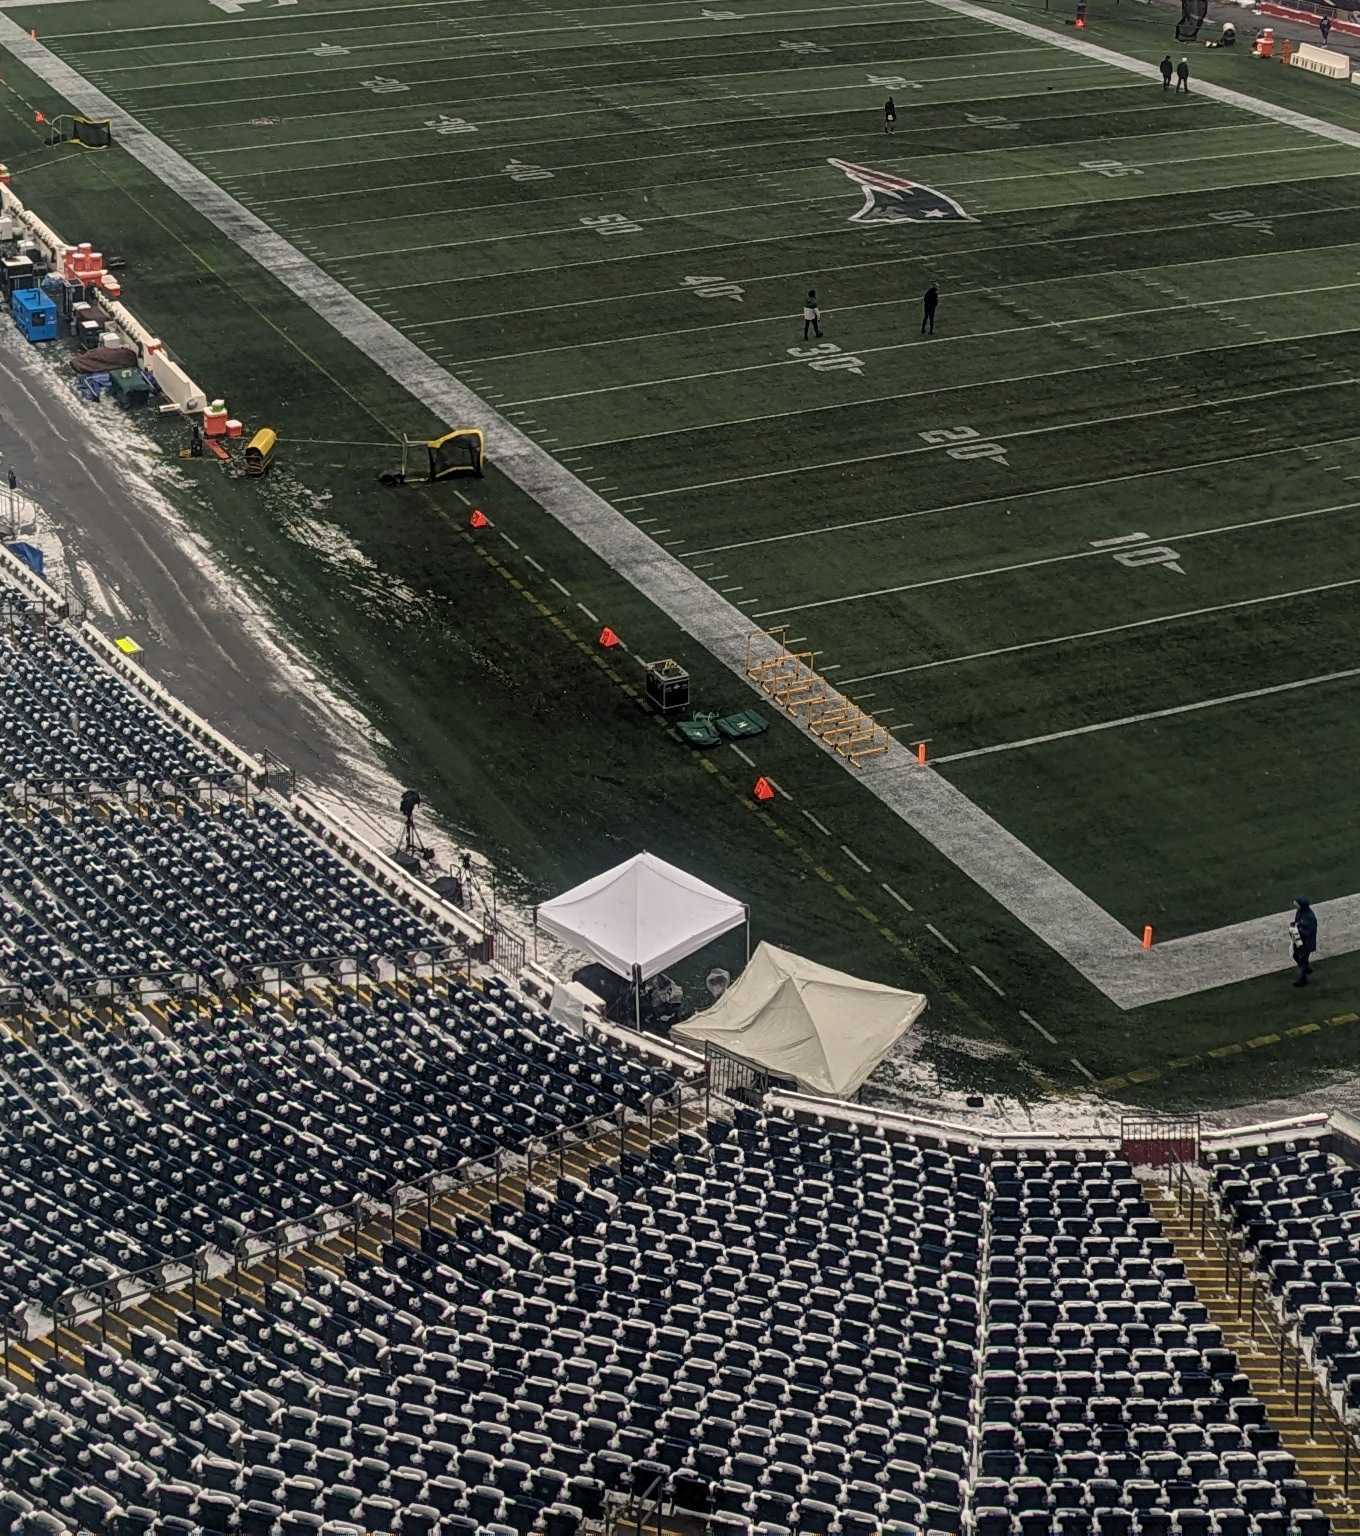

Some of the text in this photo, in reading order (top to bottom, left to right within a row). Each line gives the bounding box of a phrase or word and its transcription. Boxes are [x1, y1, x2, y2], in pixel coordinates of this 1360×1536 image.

[359, 78, 410, 94] 20
[423, 118, 479, 135] 30
[500, 162, 556, 182] 40
[1078, 159, 1144, 177] 50
[579, 213, 644, 236] 50
[679, 275, 747, 298] 40
[786, 342, 866, 373] 30
[918, 425, 1008, 461] 20
[1089, 531, 1181, 568] 10
